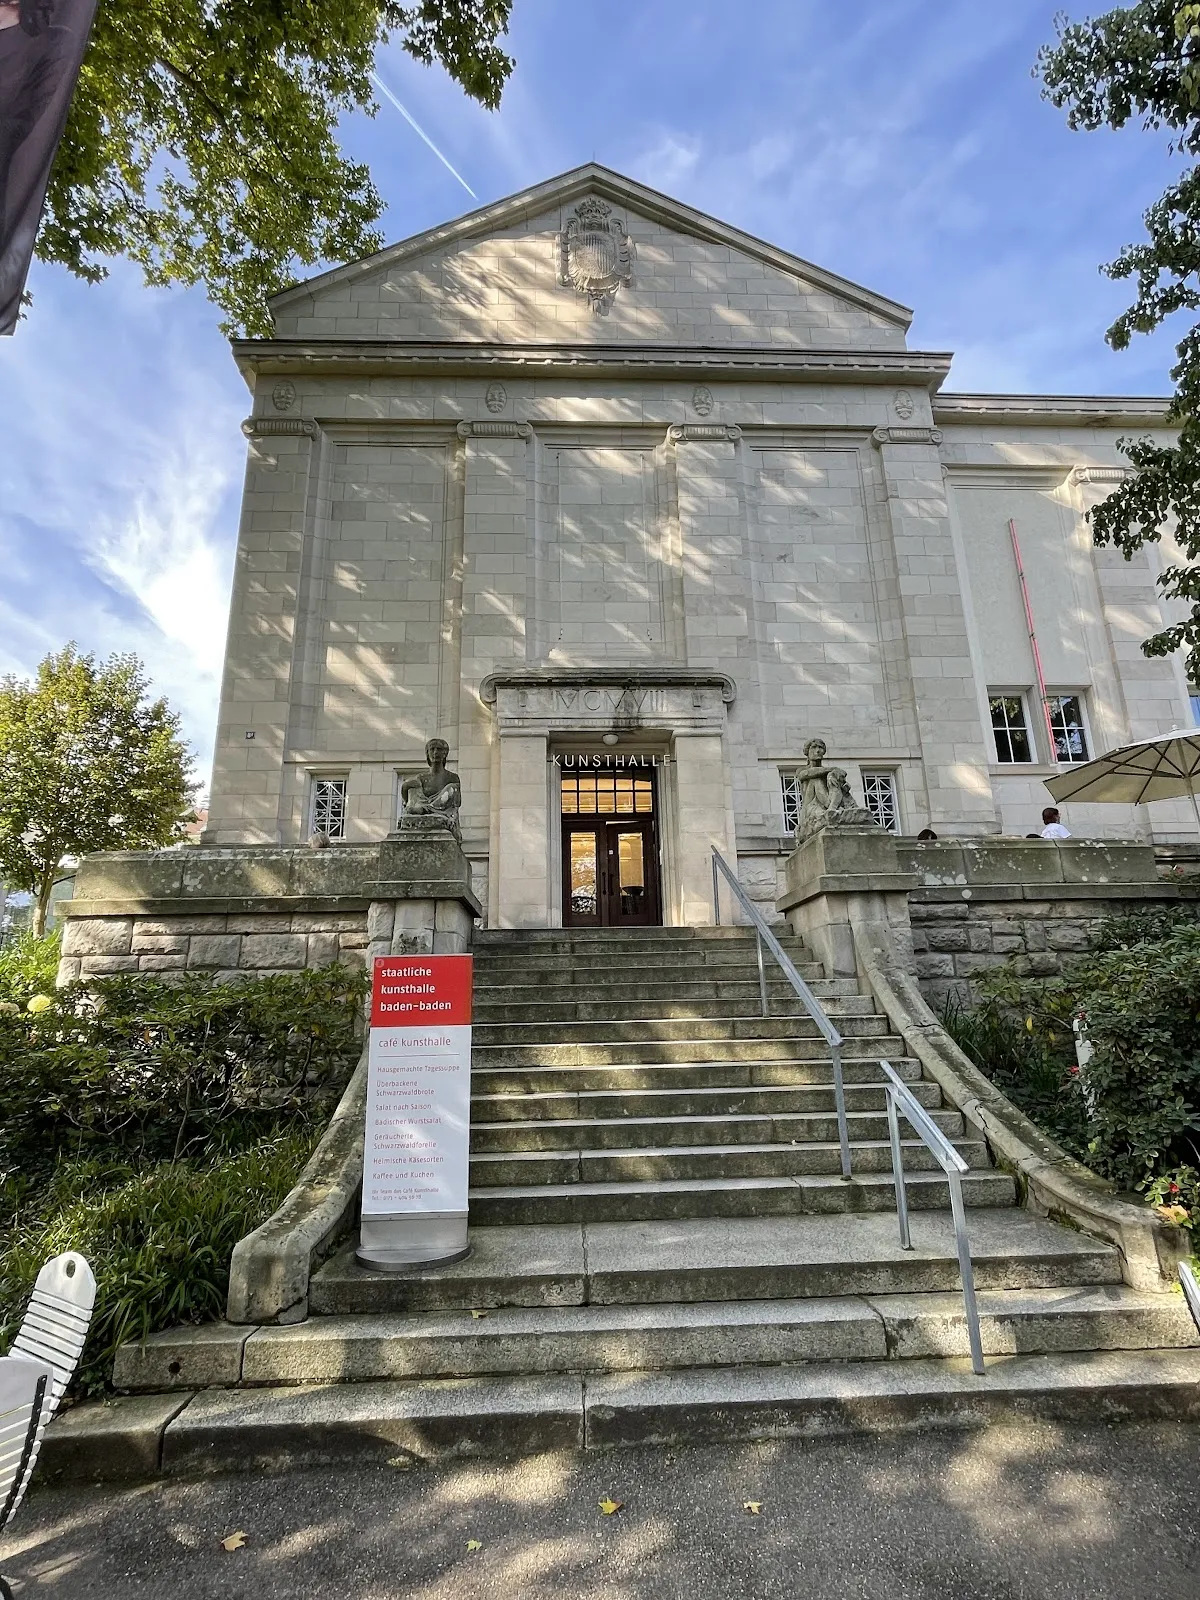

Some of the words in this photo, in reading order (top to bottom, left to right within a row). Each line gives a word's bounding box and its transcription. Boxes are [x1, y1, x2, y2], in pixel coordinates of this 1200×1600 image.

[551, 754, 671, 768] KUNSTHALLE
[381, 967, 432, 977] staatliche
[381, 983, 436, 994] kunsthalle
[380, 1000, 452, 1012] baden-baden
[378, 1037, 398, 1048] café
[401, 1036, 451, 1047] kunsthalle
[376, 1088, 435, 1096] Schwarzwaldbrote
[374, 1142, 437, 1150] Schwarzwaldforelle
